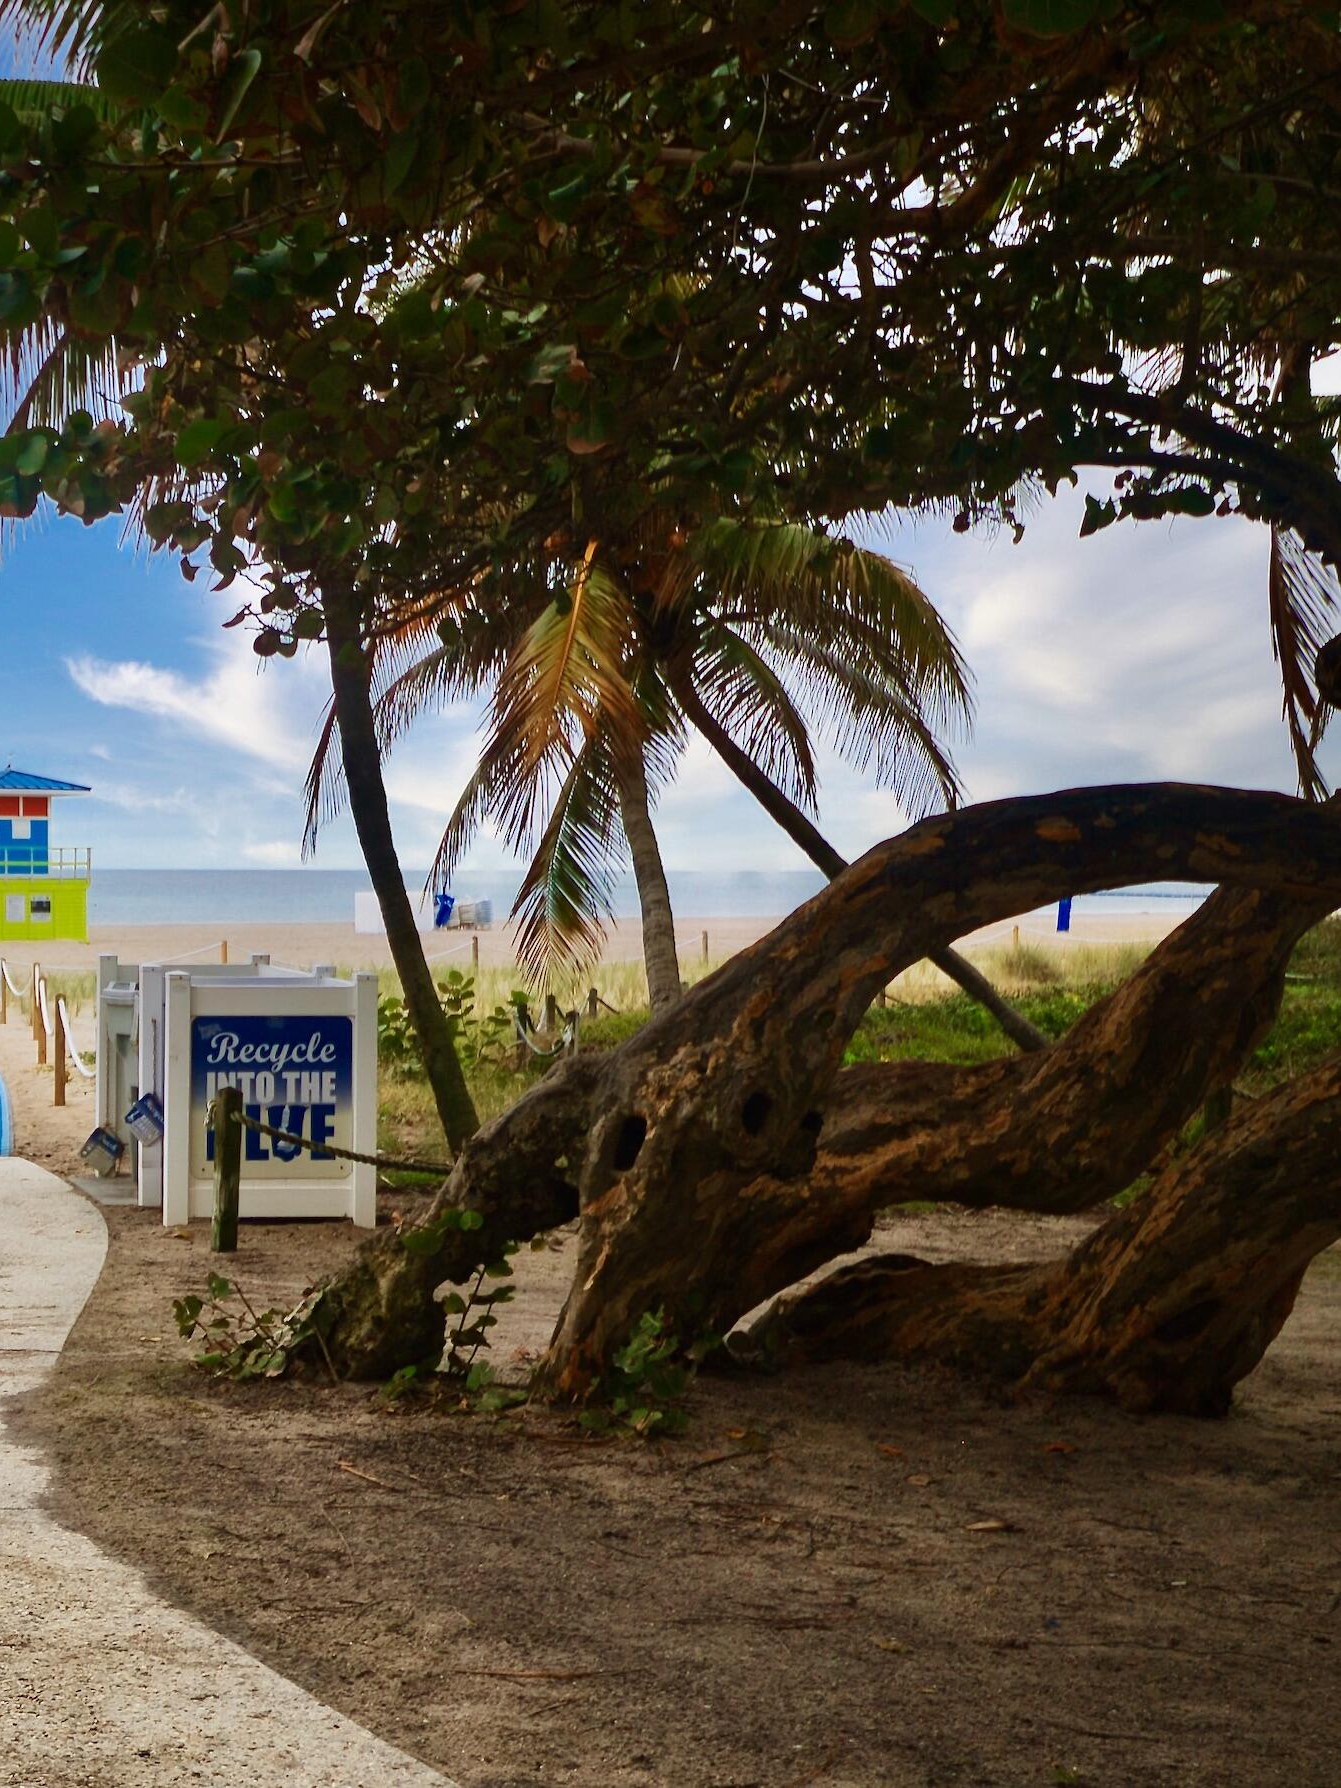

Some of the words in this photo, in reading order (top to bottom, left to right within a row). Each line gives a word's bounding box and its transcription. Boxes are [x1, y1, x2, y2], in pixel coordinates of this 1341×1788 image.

[207, 1032, 336, 1072] Recycle
[282, 1072, 336, 1104] THE
[206, 1104, 336, 1161] LUE
